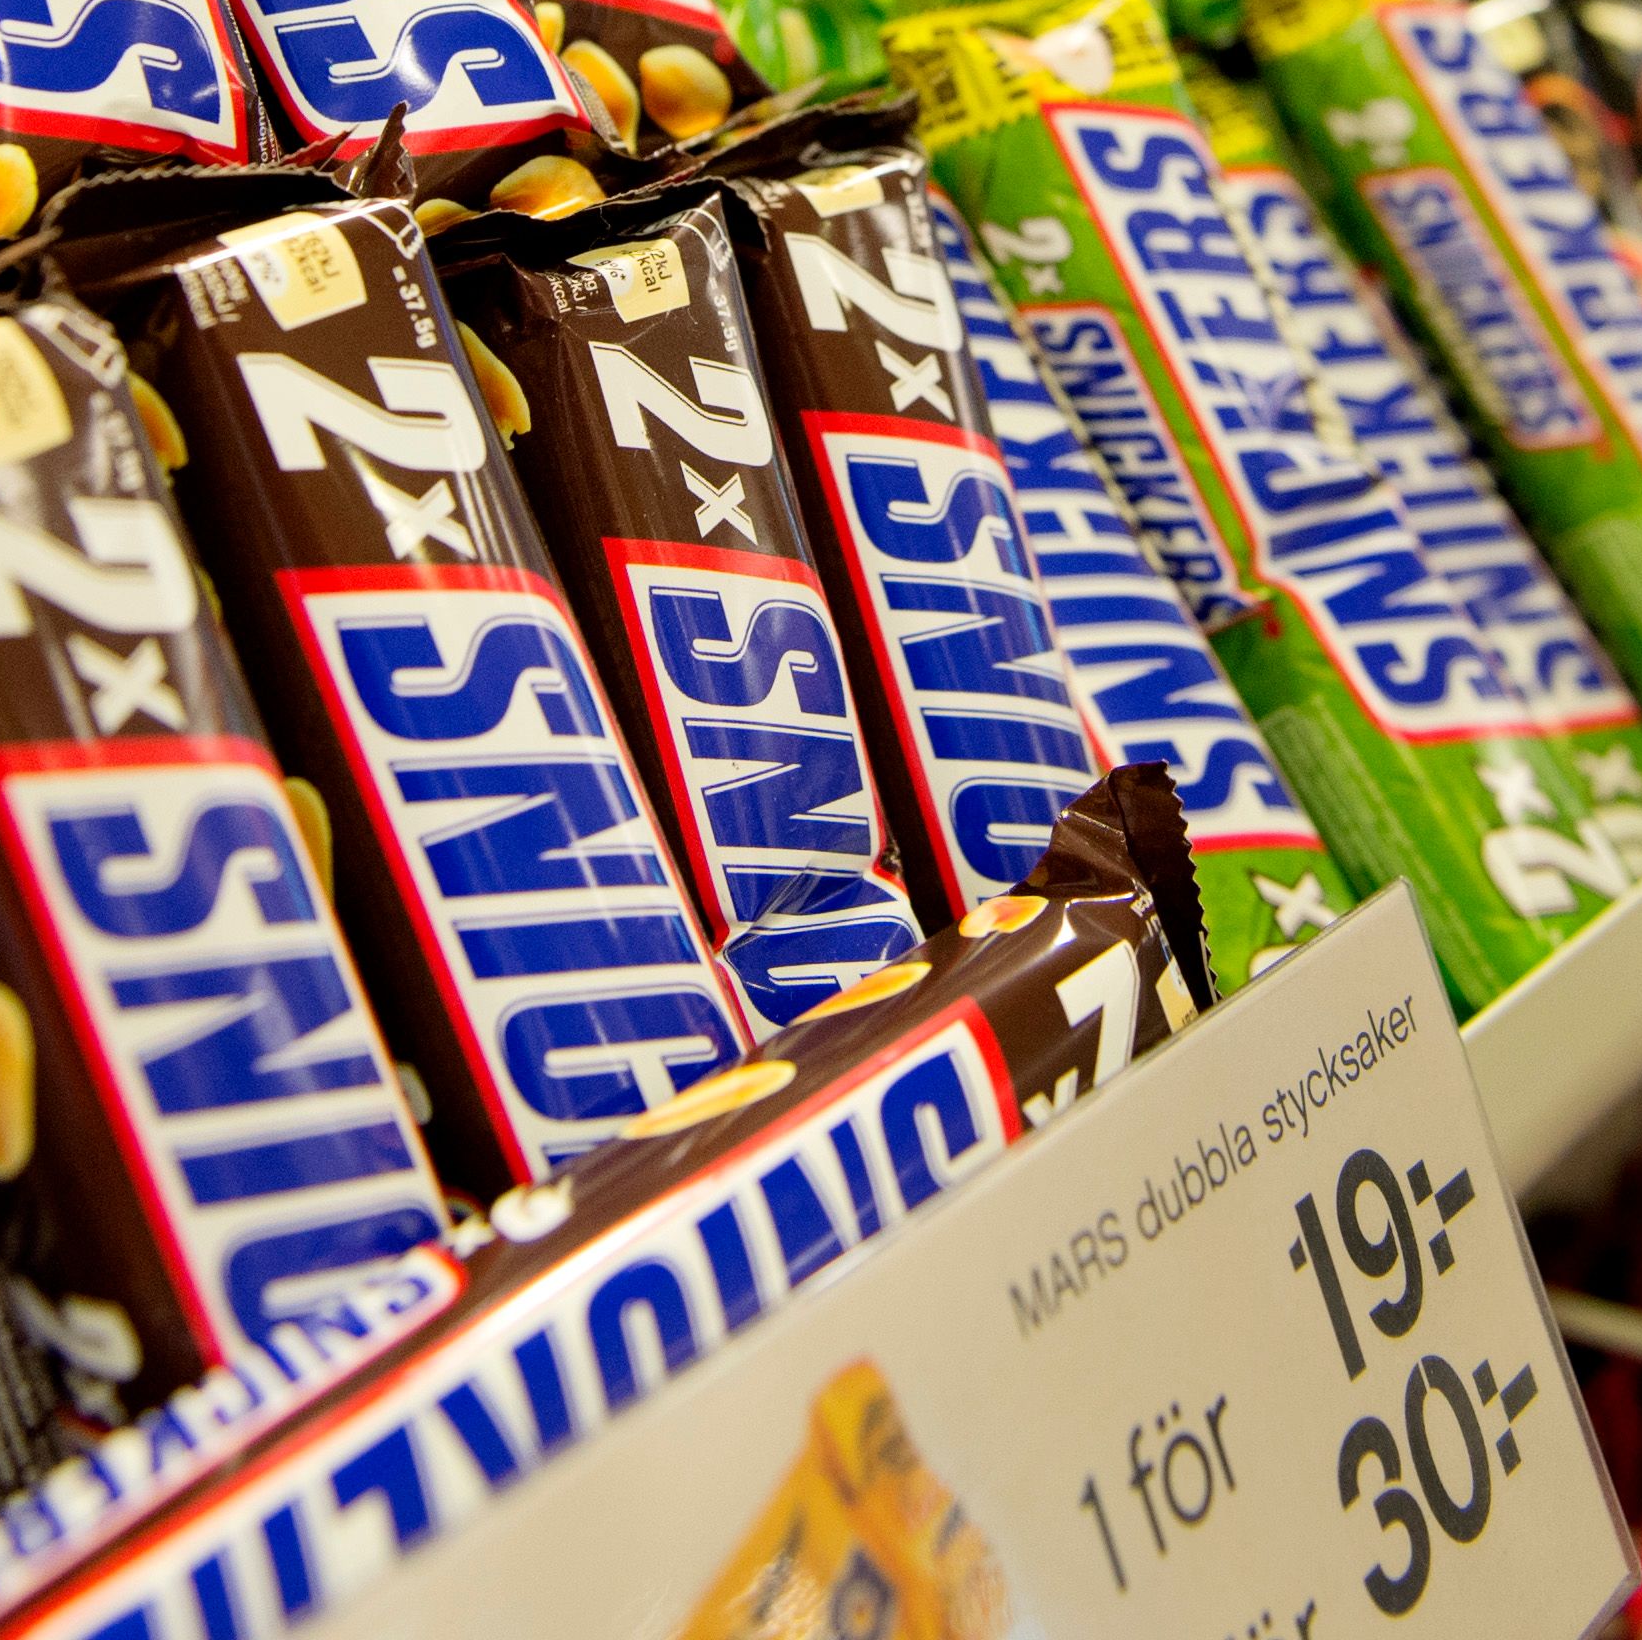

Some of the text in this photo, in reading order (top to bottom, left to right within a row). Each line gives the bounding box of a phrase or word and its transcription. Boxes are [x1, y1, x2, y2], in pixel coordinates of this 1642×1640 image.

[399, 282, 438, 350] 37.5g
[588, 340, 774, 545] 2x
[713, 293, 739, 353] 37.5g
[783, 230, 961, 422] 2x
[982, 216, 1250, 627] 2x SNICKERS
[1078, 123, 1509, 712] SNICKERS
[237, 350, 752, 1166] 2x SNIC
[1479, 756, 1635, 920] 2x
[1007, 1209, 1128, 1340] MARS
[1134, 1123, 1259, 1244] dubbla
[1261, 994, 1420, 1142] stycksaker
[1079, 1147, 1477, 1594] 1 för 19:-
[1336, 1353, 1540, 1618] 30:-
